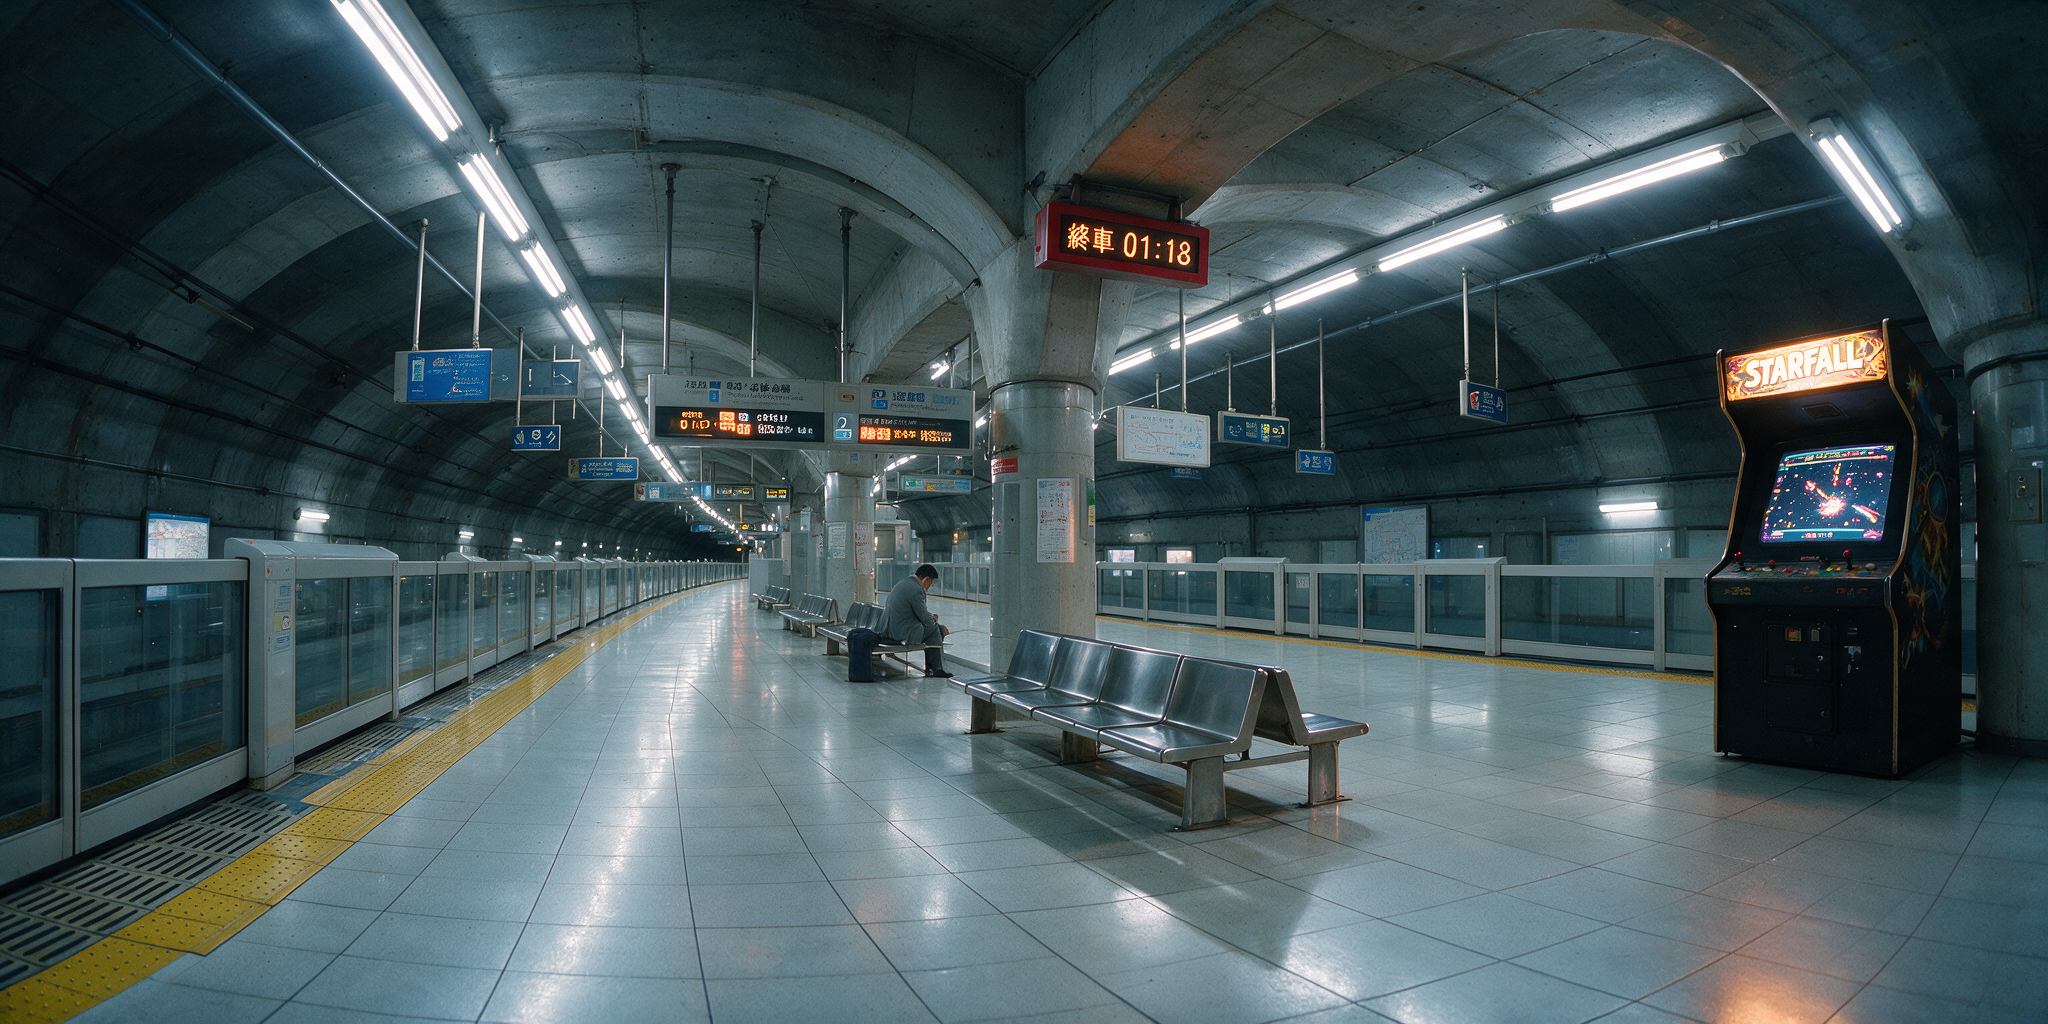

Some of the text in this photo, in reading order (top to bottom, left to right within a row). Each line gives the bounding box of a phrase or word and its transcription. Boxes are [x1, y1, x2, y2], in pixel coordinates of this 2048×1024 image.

[1067, 222, 1192, 267] 終車 01:18
[1744, 340, 1864, 388] STARFALL
